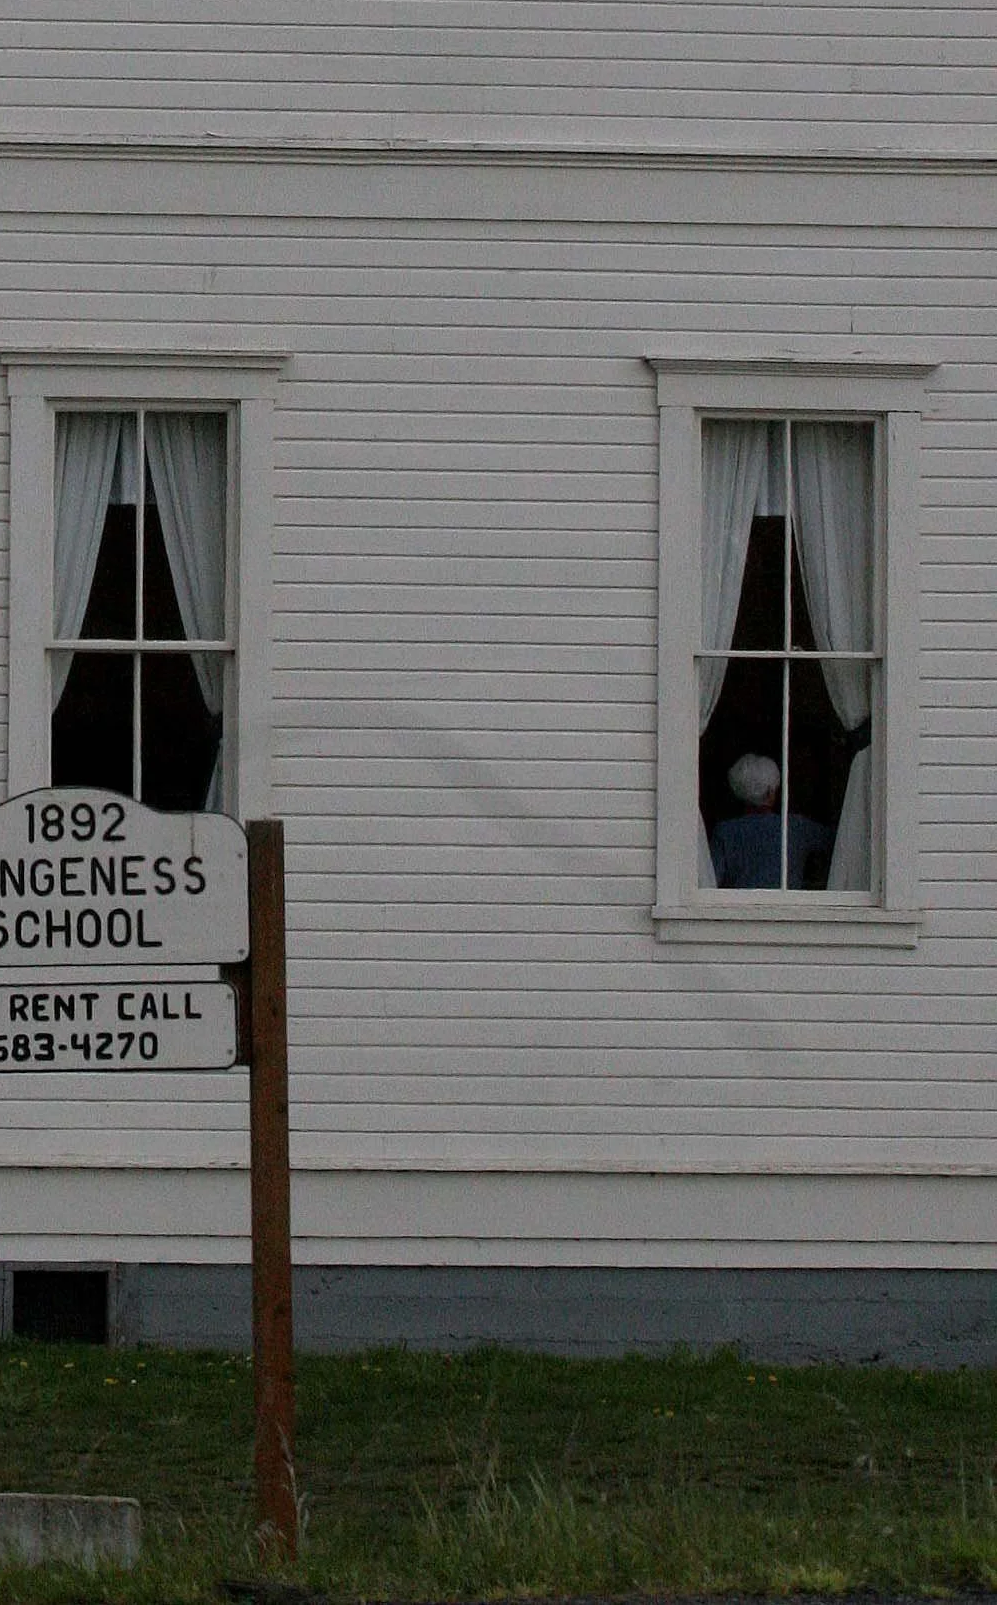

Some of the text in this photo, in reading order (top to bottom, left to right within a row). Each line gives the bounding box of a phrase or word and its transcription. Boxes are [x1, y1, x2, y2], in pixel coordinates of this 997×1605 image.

[24, 801, 126, 844] 1892
[9, 992, 100, 1022] RENT
[117, 991, 203, 1021] CALL
